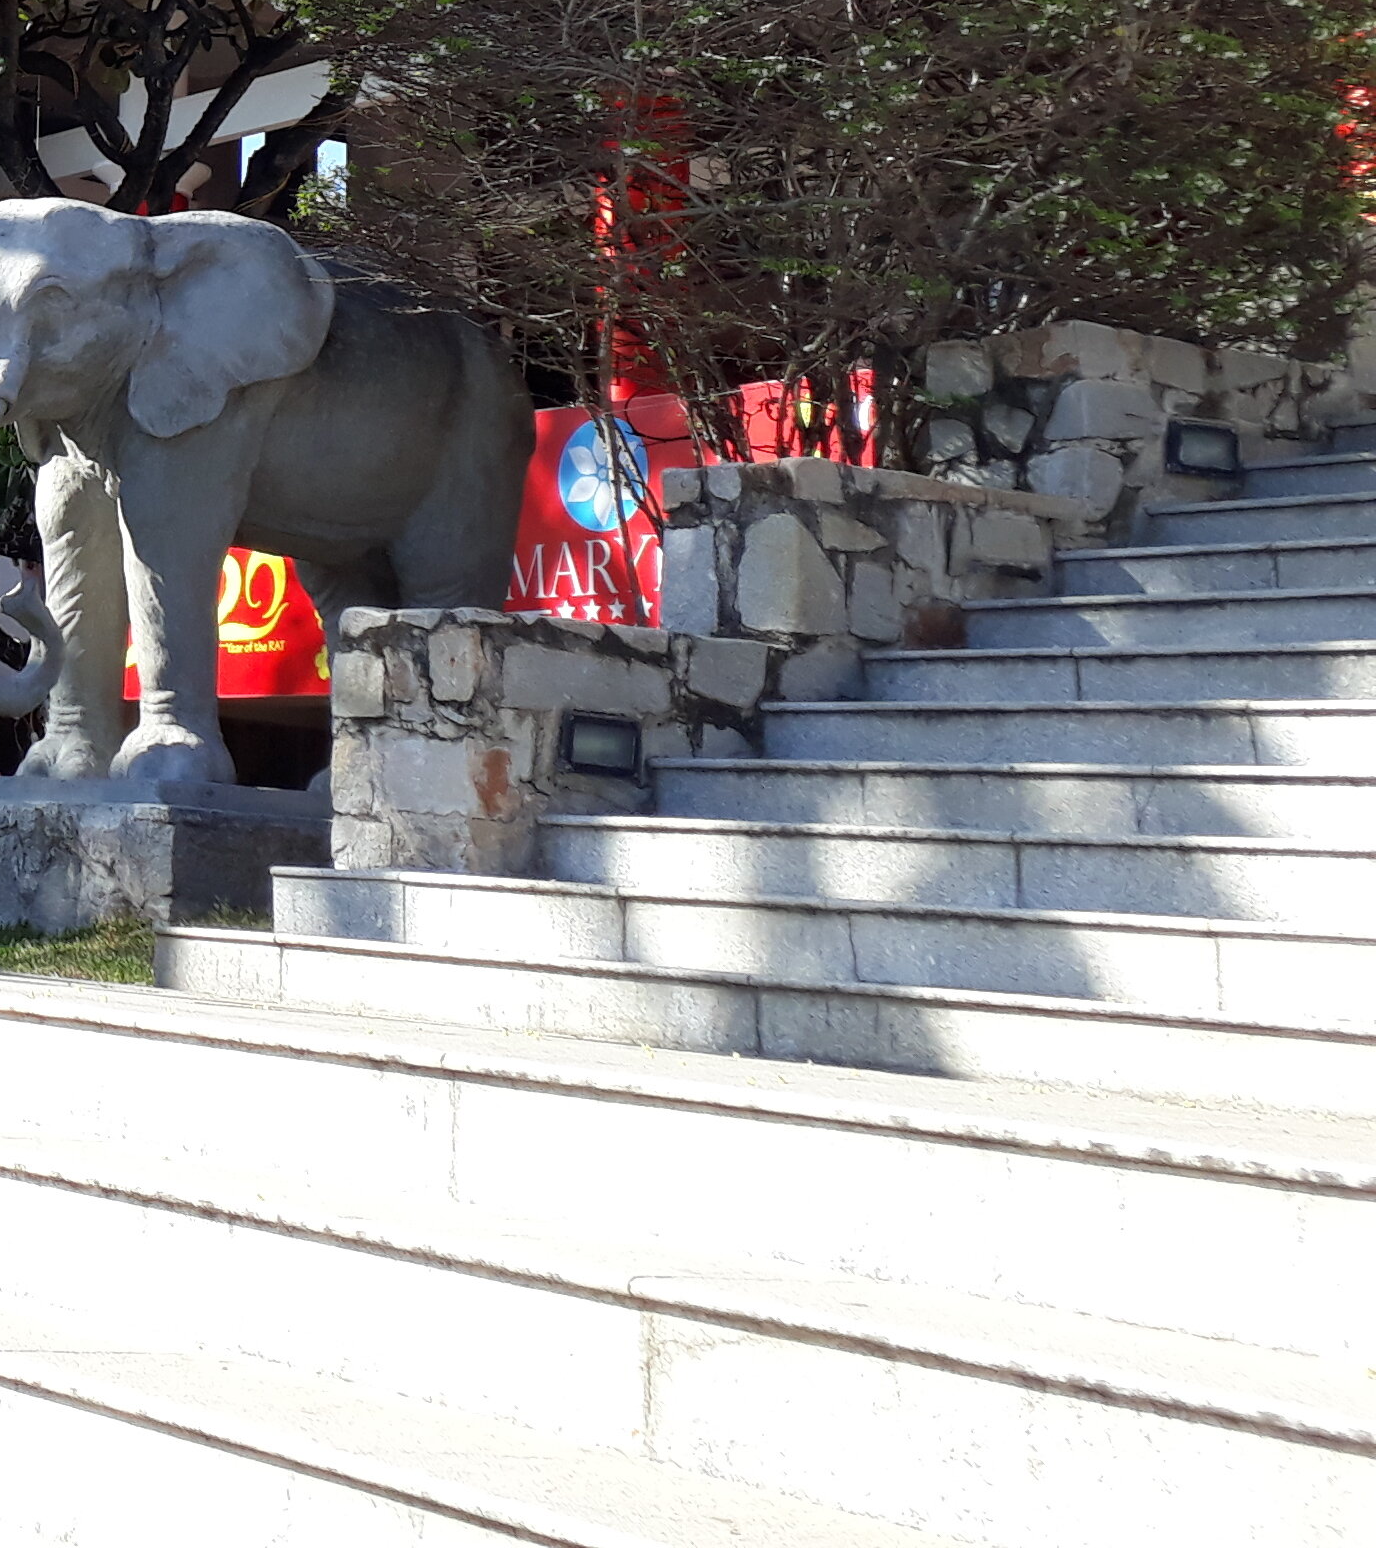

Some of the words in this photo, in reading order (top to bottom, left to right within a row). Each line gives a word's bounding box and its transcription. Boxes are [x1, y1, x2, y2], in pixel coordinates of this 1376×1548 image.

[244, 641, 254, 653] of
[254, 641, 268, 653] the
[268, 639, 286, 652] RAT
